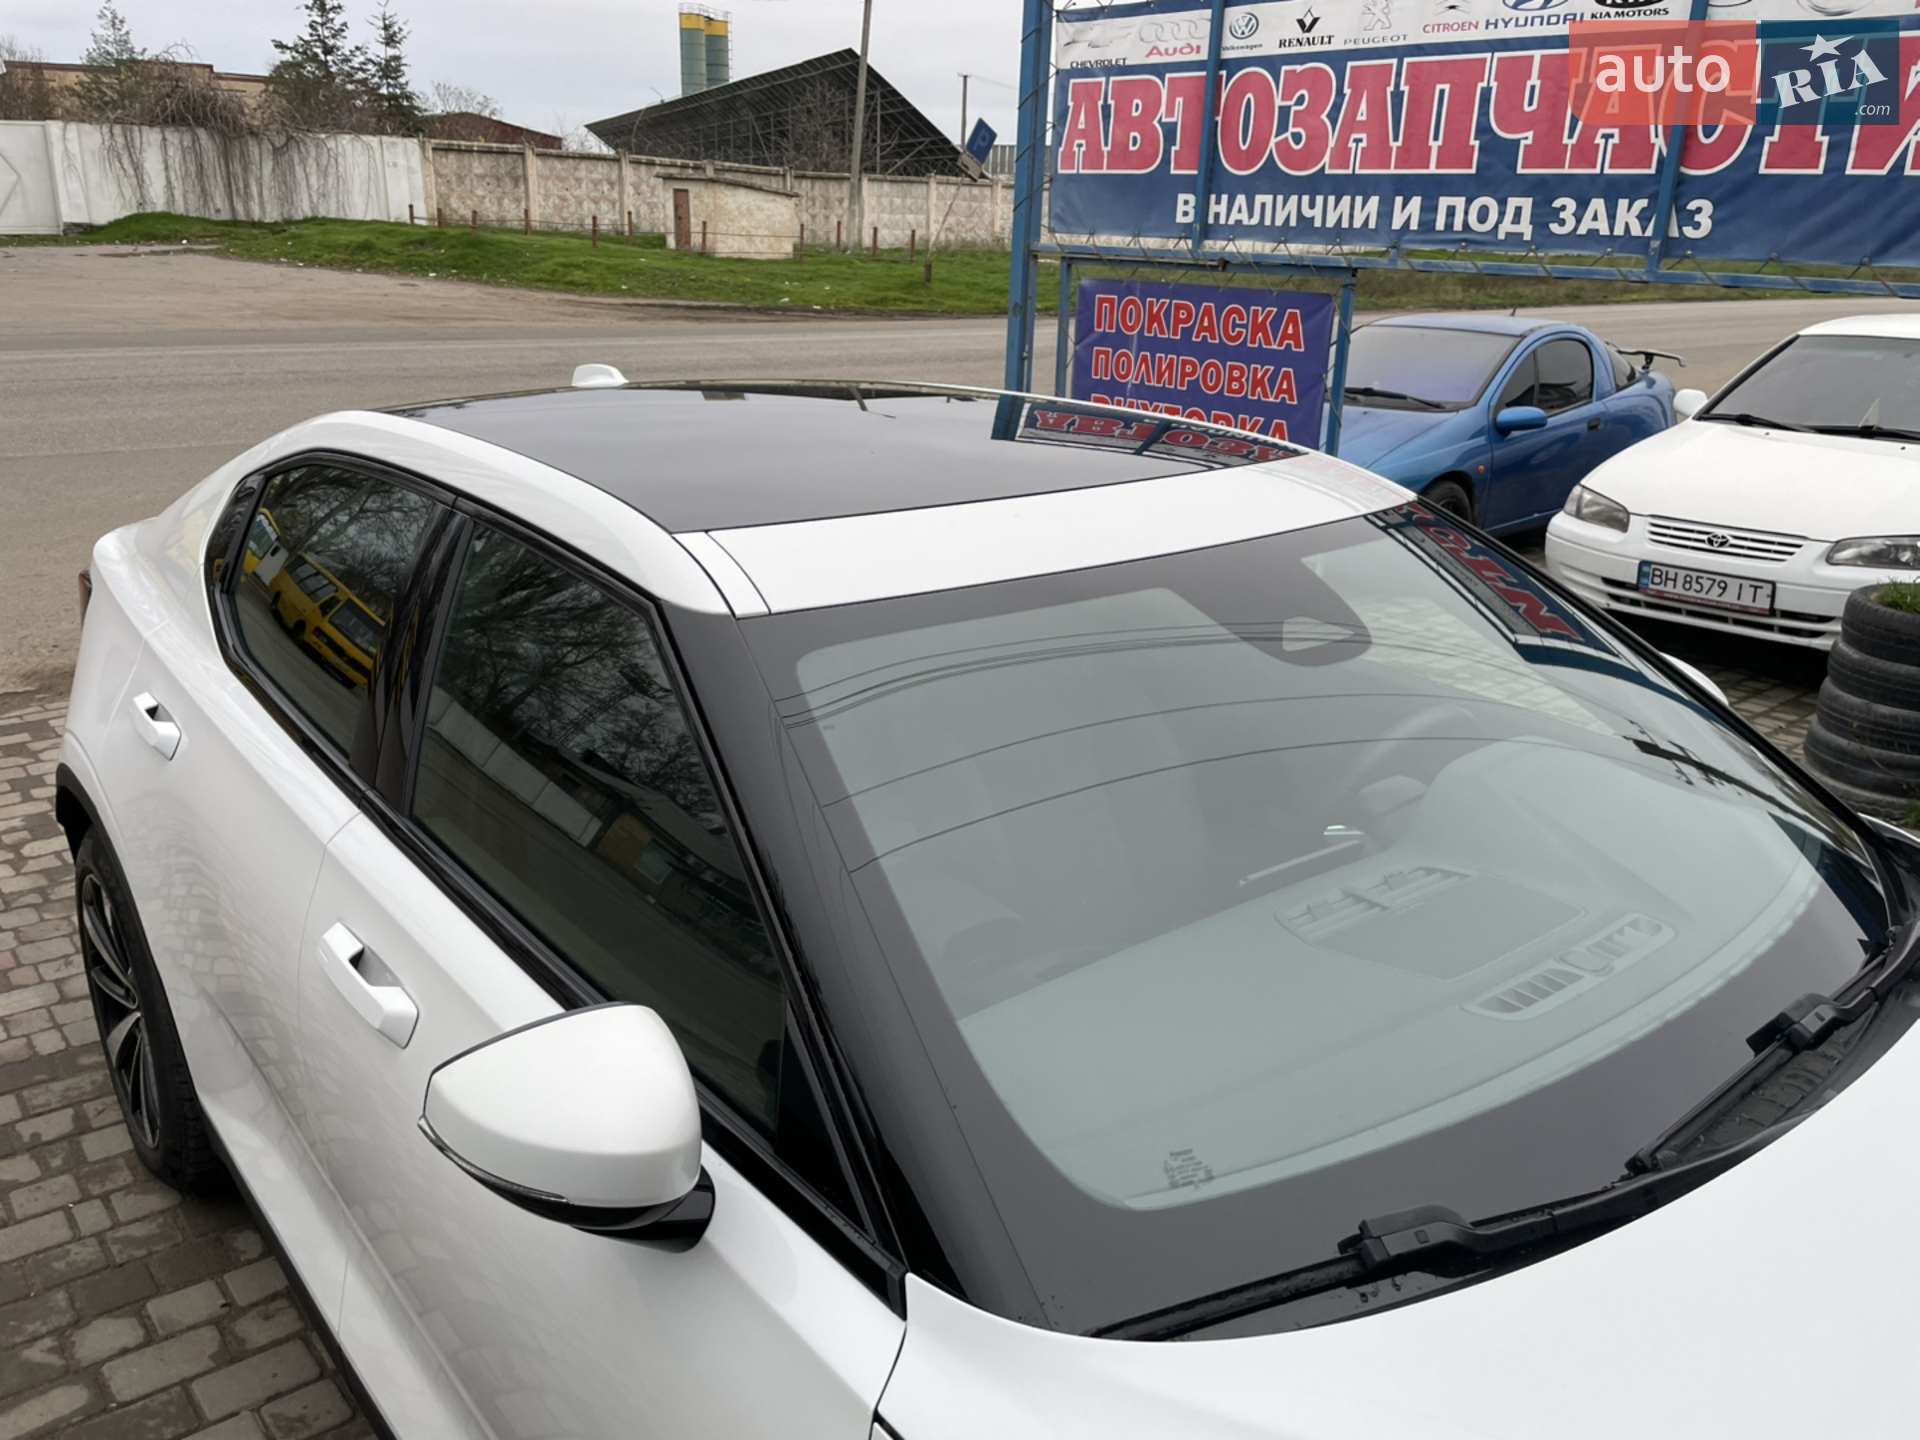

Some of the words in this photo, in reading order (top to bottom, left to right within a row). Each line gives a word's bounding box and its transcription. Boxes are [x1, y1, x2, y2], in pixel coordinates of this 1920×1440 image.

[1485, 12, 1585, 30] HYUNDAI
[1591, 11, 1612, 20] KIA
[1614, 7, 1670, 19] MOTORS
[1422, 20, 1480, 34] CITROEN
[1221, 43, 1263, 52] Volkswagen
[1278, 35, 1334, 49] RENAULT
[1343, 34, 1408, 46] PEUGEOT
[1145, 42, 1202, 58] Audi
[1070, 57, 1128, 69] CHEVROLET
[1175, 193, 1196, 224] В
[1207, 193, 1380, 229] НАЛИЧИИ
[1391, 195, 1422, 231] И
[1435, 196, 1533, 241] ПОД
[1094, 294, 1305, 352] ПОКРАСКА
[1091, 347, 1298, 404] ПОЛИРОВКА
[1651, 567, 1678, 590] BH
[1682, 573, 1728, 598] 8579
[1736, 583, 1764, 604] IT
